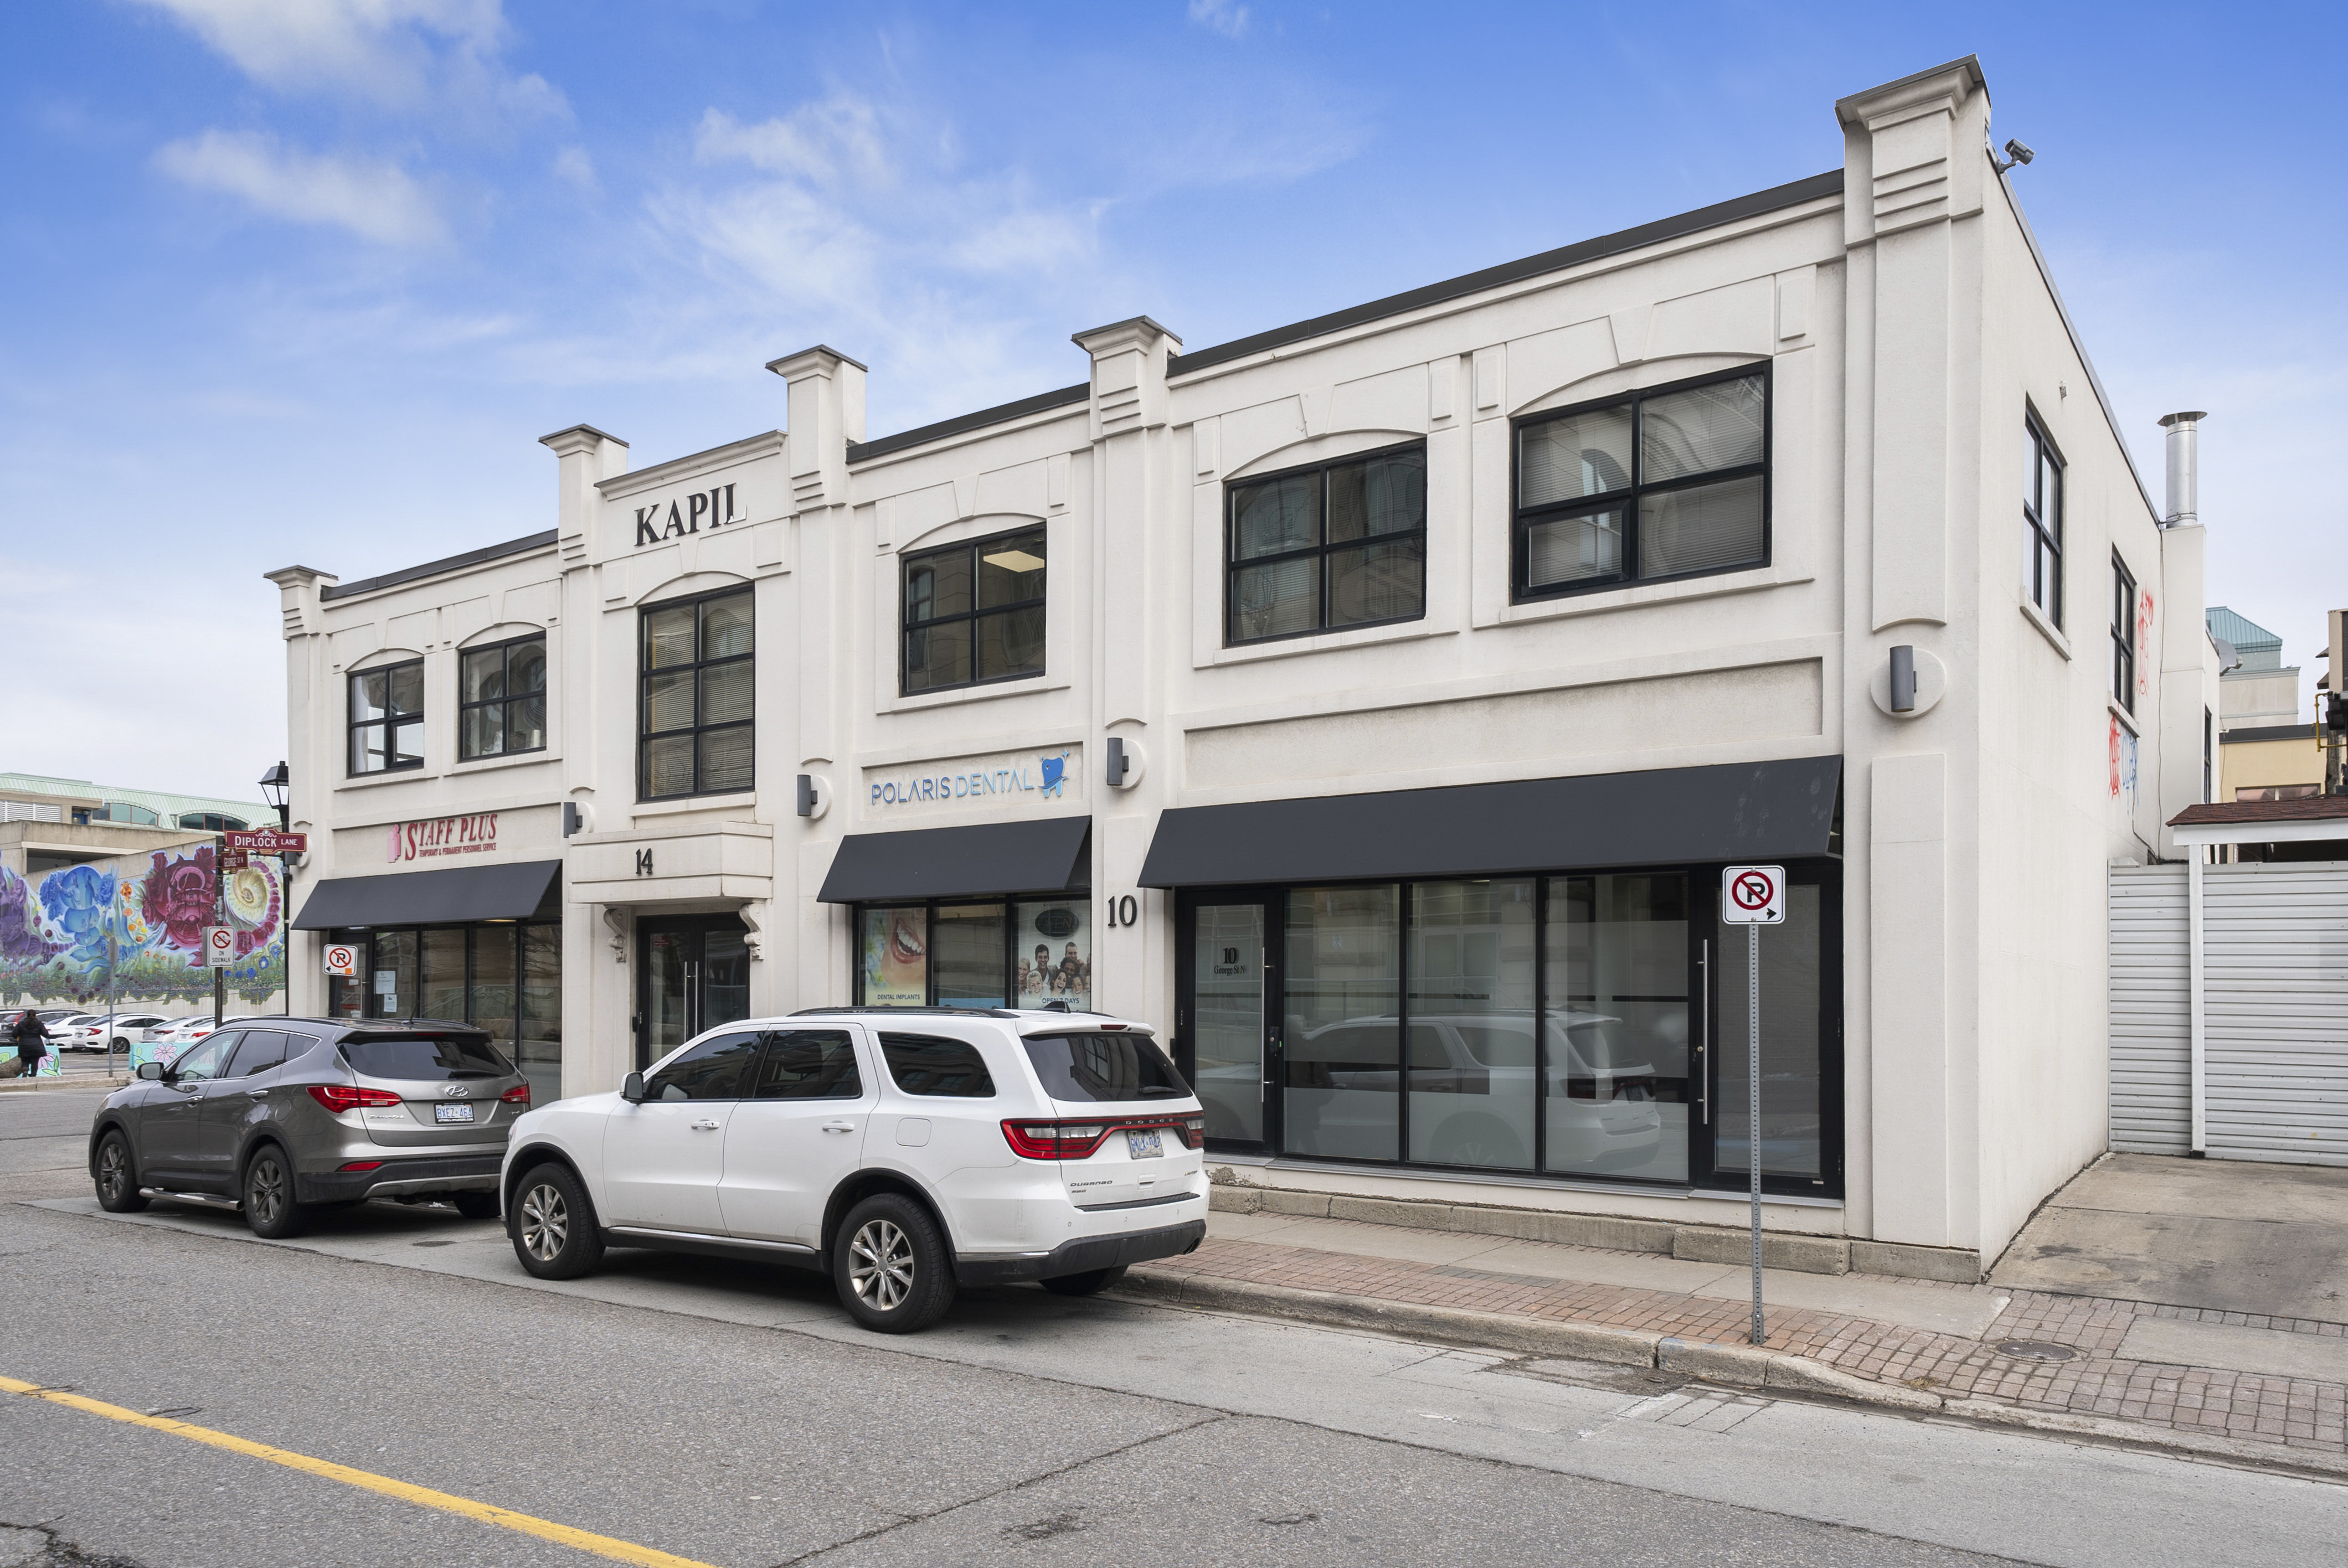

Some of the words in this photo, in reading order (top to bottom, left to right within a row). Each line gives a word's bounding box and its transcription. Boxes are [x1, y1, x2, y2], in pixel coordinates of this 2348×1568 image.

[634, 482, 748, 547] KAPIL
[872, 776, 951, 805] POLARIS
[956, 768, 1034, 797] DENTAL
[234, 835, 277, 847] DIPLOCK
[405, 819, 455, 861] STAFF
[459, 813, 497, 842] PLUS
[482, 842, 497, 852] SERVICE
[635, 848, 653, 874] 14
[1107, 895, 1137, 927] 10
[1222, 947, 1237, 964] 10
[1214, 965, 1233, 976] George
